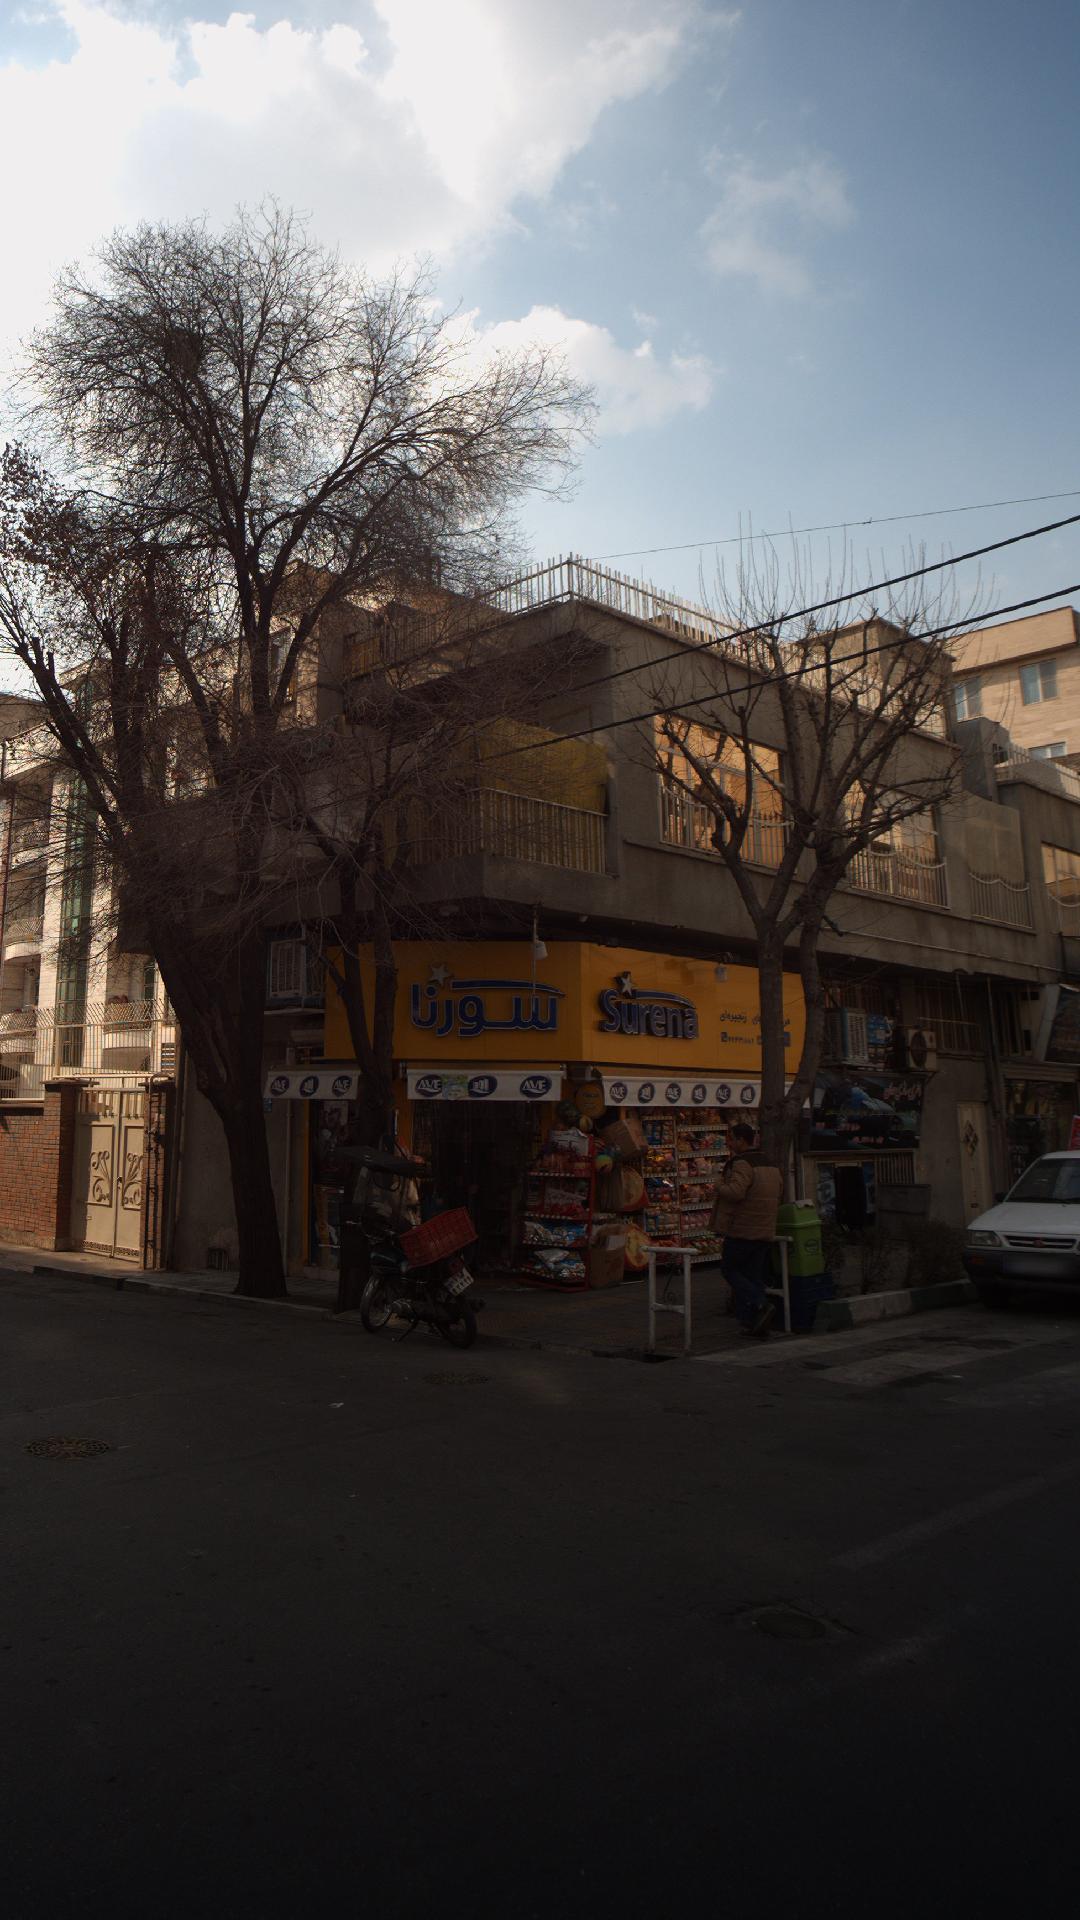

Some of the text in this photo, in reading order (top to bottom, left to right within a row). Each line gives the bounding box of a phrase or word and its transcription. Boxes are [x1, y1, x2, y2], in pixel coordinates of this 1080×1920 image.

[411, 979, 565, 1037] سورنا
[599, 988, 699, 1039] Surena
[523, 1078, 547, 1092] AVE
